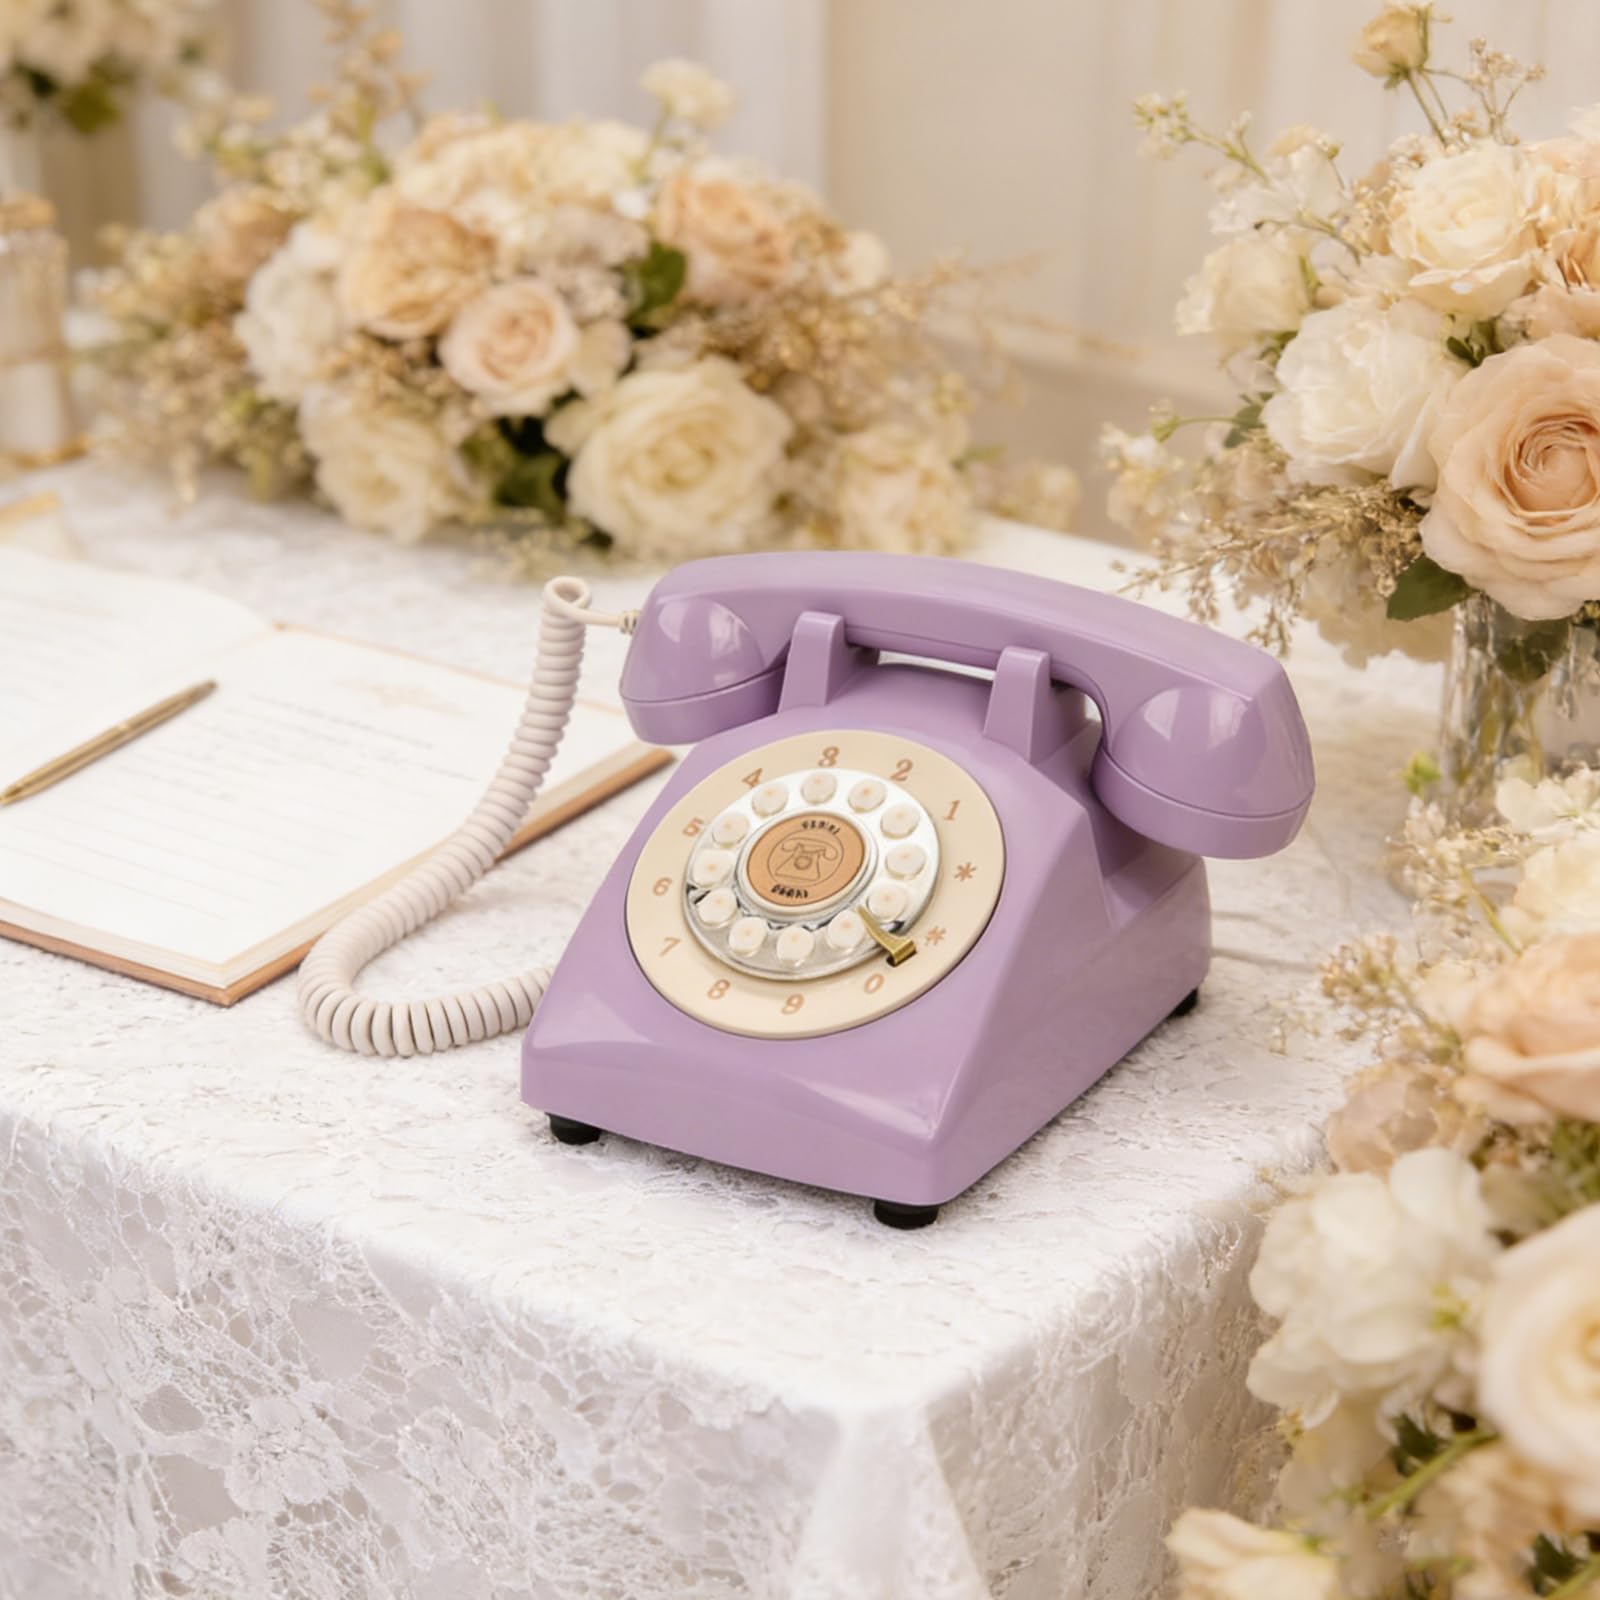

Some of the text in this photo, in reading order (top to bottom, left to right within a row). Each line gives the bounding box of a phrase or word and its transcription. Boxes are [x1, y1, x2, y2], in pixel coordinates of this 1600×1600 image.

[818, 746, 841, 769] 3
[742, 767, 764, 788] 4
[890, 758, 914, 782] 2
[944, 800, 962, 822] 1
[682, 817, 704, 837] 5
[652, 876, 673, 896] 6
[659, 937, 681, 958] 7
[707, 979, 731, 1000] 8
[864, 973, 885, 994] 0
[781, 993, 805, 1014] 9
